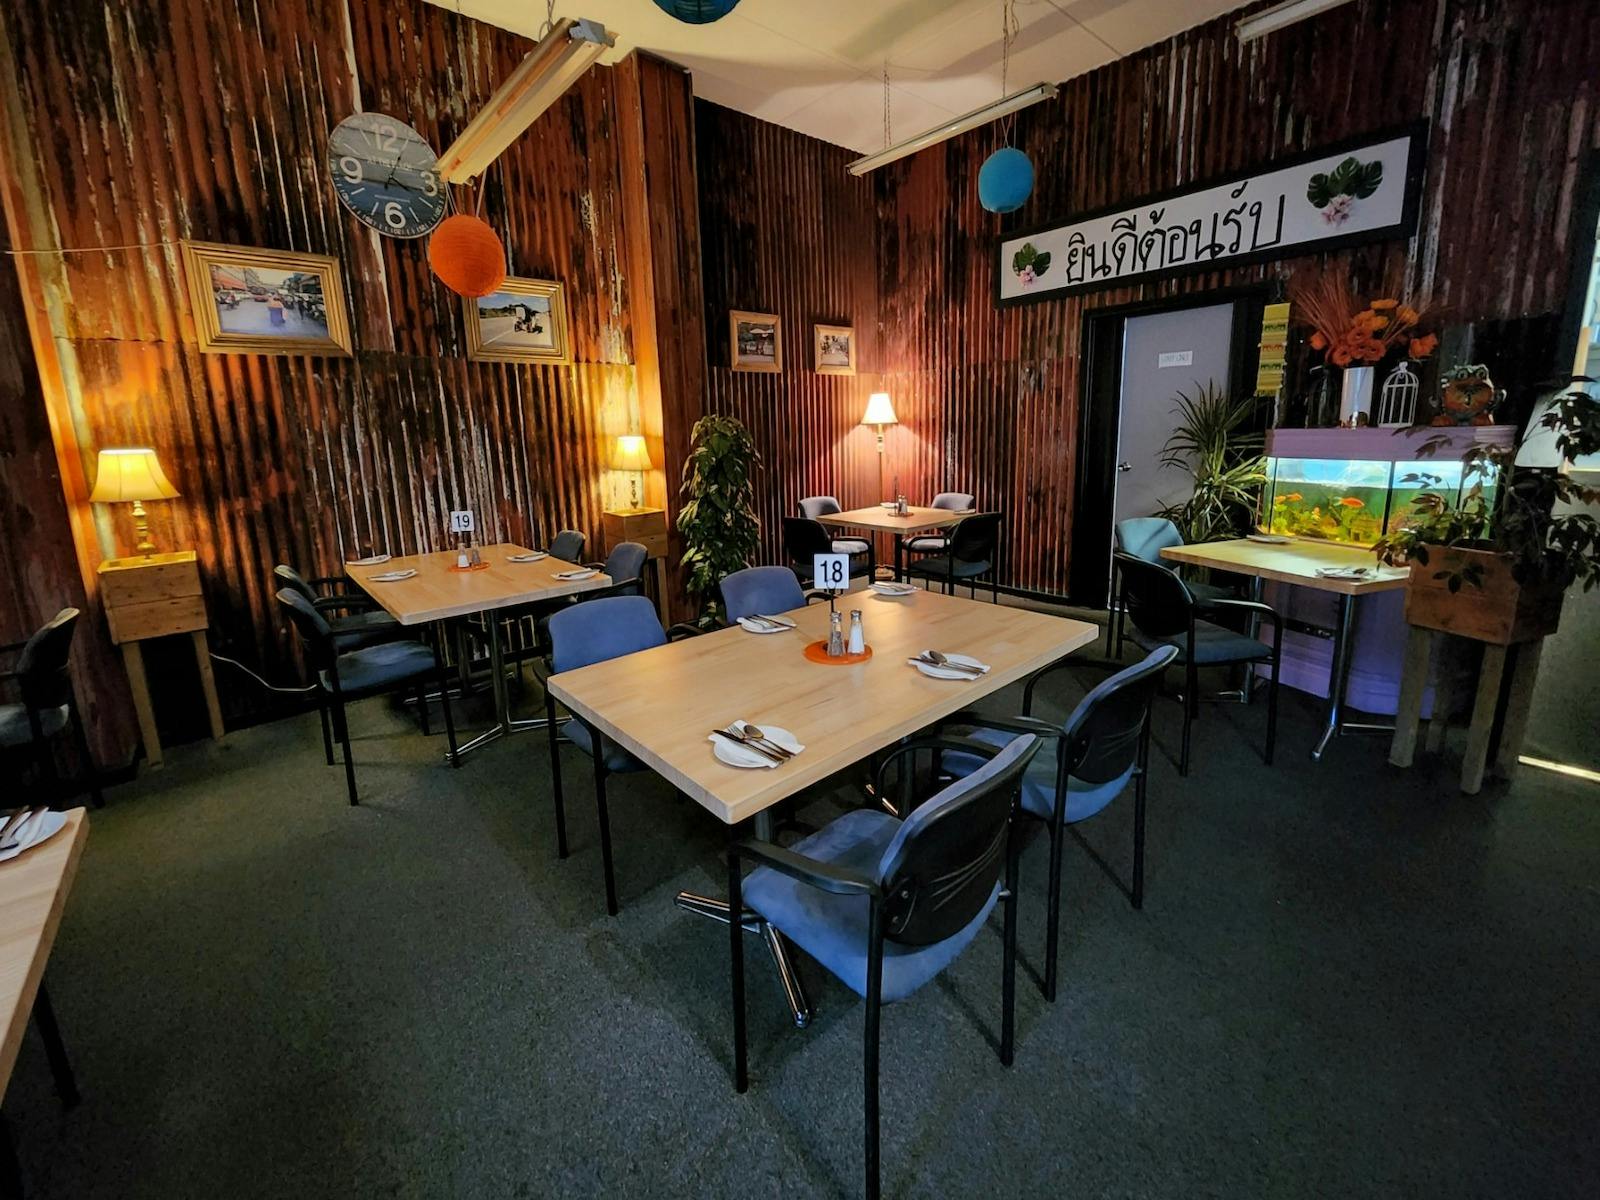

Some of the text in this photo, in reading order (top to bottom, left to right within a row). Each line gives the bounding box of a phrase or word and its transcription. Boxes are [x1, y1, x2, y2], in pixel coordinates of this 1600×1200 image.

[370, 123, 400, 153] 12
[340, 157, 363, 184] 9
[420, 170, 438, 197] 3
[384, 202, 406, 229] 6
[1066, 181, 1286, 284] ยินดีต้อนรับ
[455, 514, 470, 528] 19
[820, 560, 843, 583] 18
